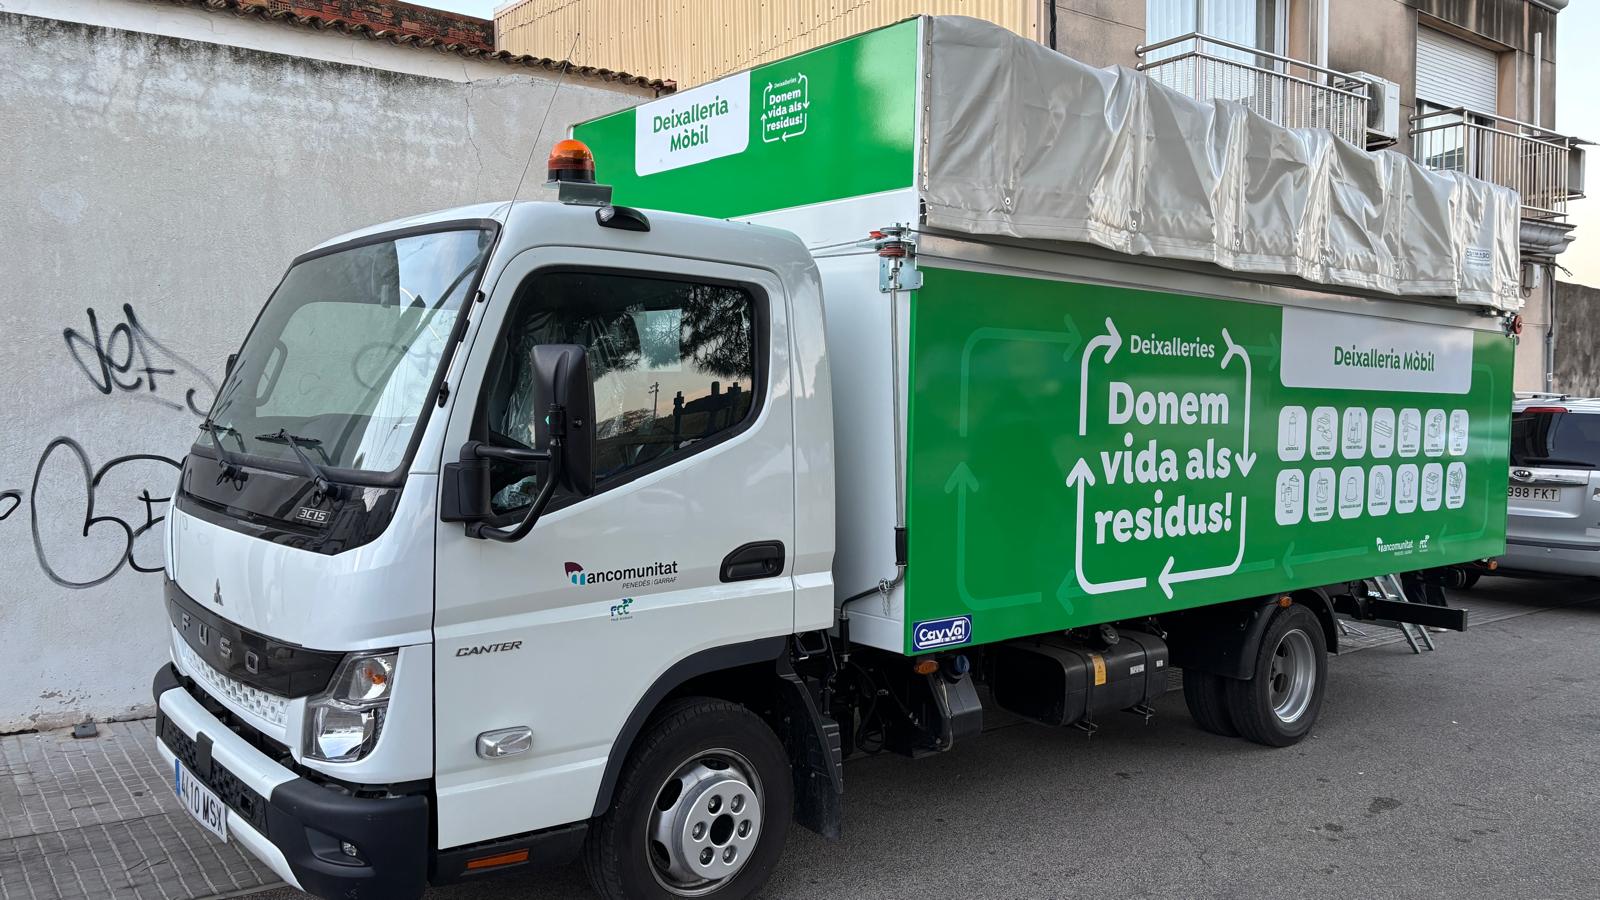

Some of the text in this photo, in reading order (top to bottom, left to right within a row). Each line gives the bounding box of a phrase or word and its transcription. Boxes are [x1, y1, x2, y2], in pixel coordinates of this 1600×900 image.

[768, 101, 802, 118] vida als
[769, 89, 801, 105] Donem
[653, 95, 729, 133] Deixalleria
[766, 113, 803, 132] residus!
[669, 125, 709, 152] Mòbil
[1130, 333, 1215, 358] Deixalleries
[1334, 345, 1435, 372] Deixalleria Mòbil
[1108, 381, 1229, 425] Donem
[1100, 432, 1232, 485] vida als
[1533, 488, 1558, 500] FKT
[299, 509, 327, 521] 3C15
[1094, 489, 1233, 545] residus!
[654, 576, 678, 586] GARRAF
[181, 612, 259, 675] FUSO
[455, 640, 523, 658] CANTER
[181, 770, 224, 836] 4410 MSX
